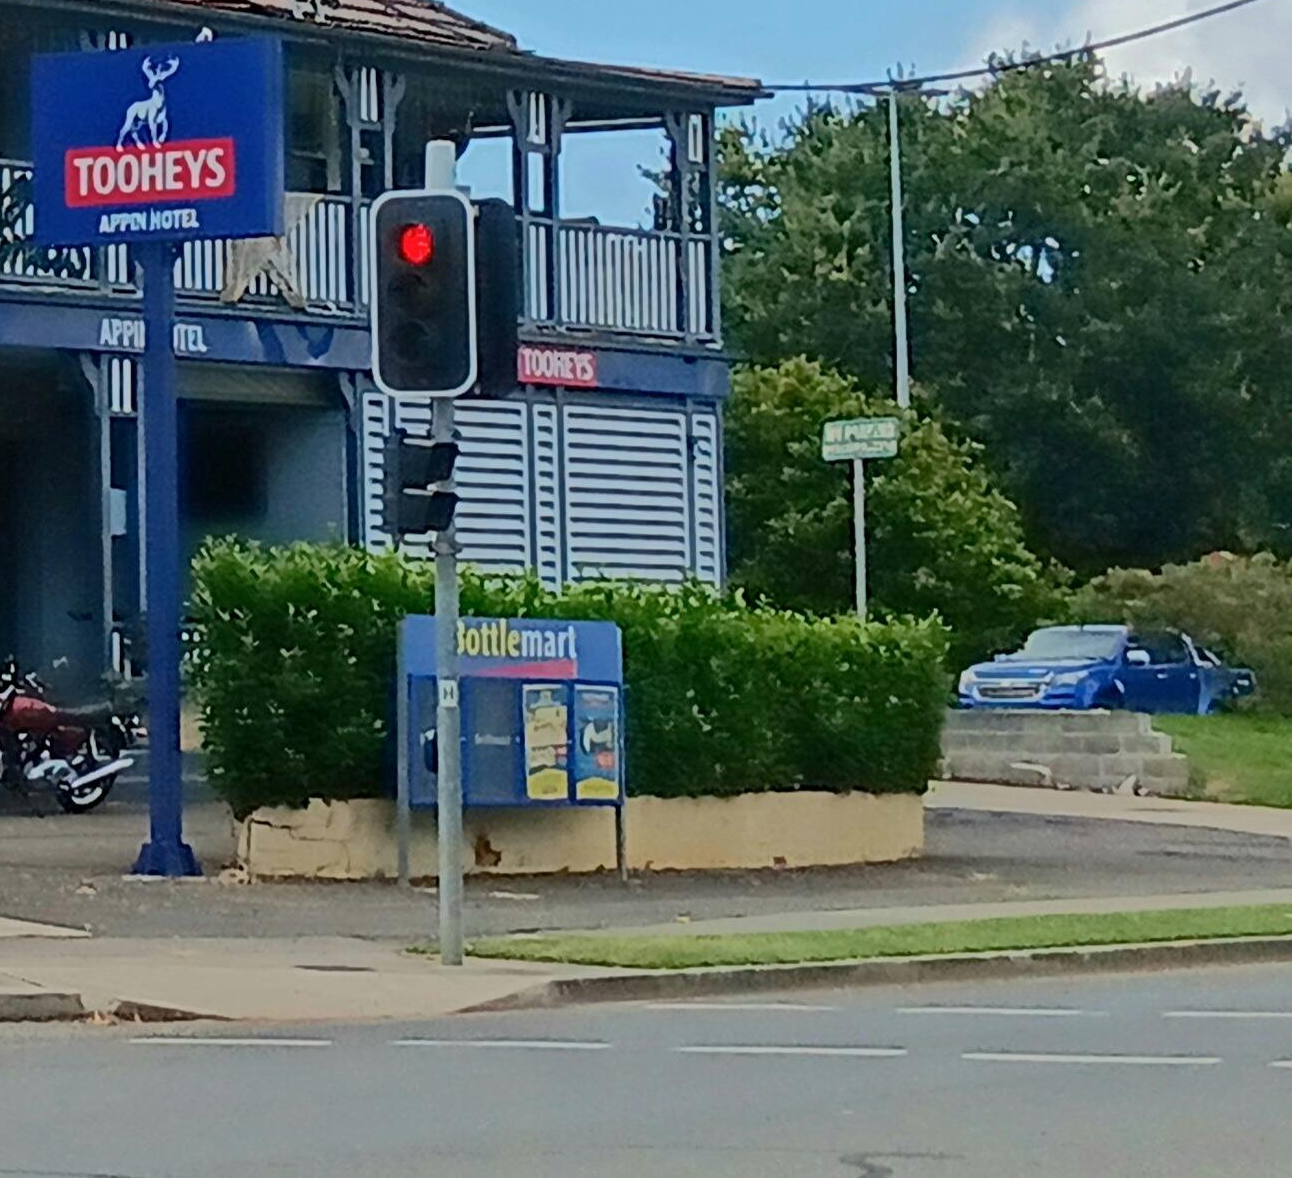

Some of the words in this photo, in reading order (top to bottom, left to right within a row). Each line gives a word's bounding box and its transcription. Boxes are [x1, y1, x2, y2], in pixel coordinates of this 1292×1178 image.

[73, 147, 226, 196] TOOHEYS
[149, 208, 200, 231] HOTEL
[522, 348, 595, 381] TOOHEYS
